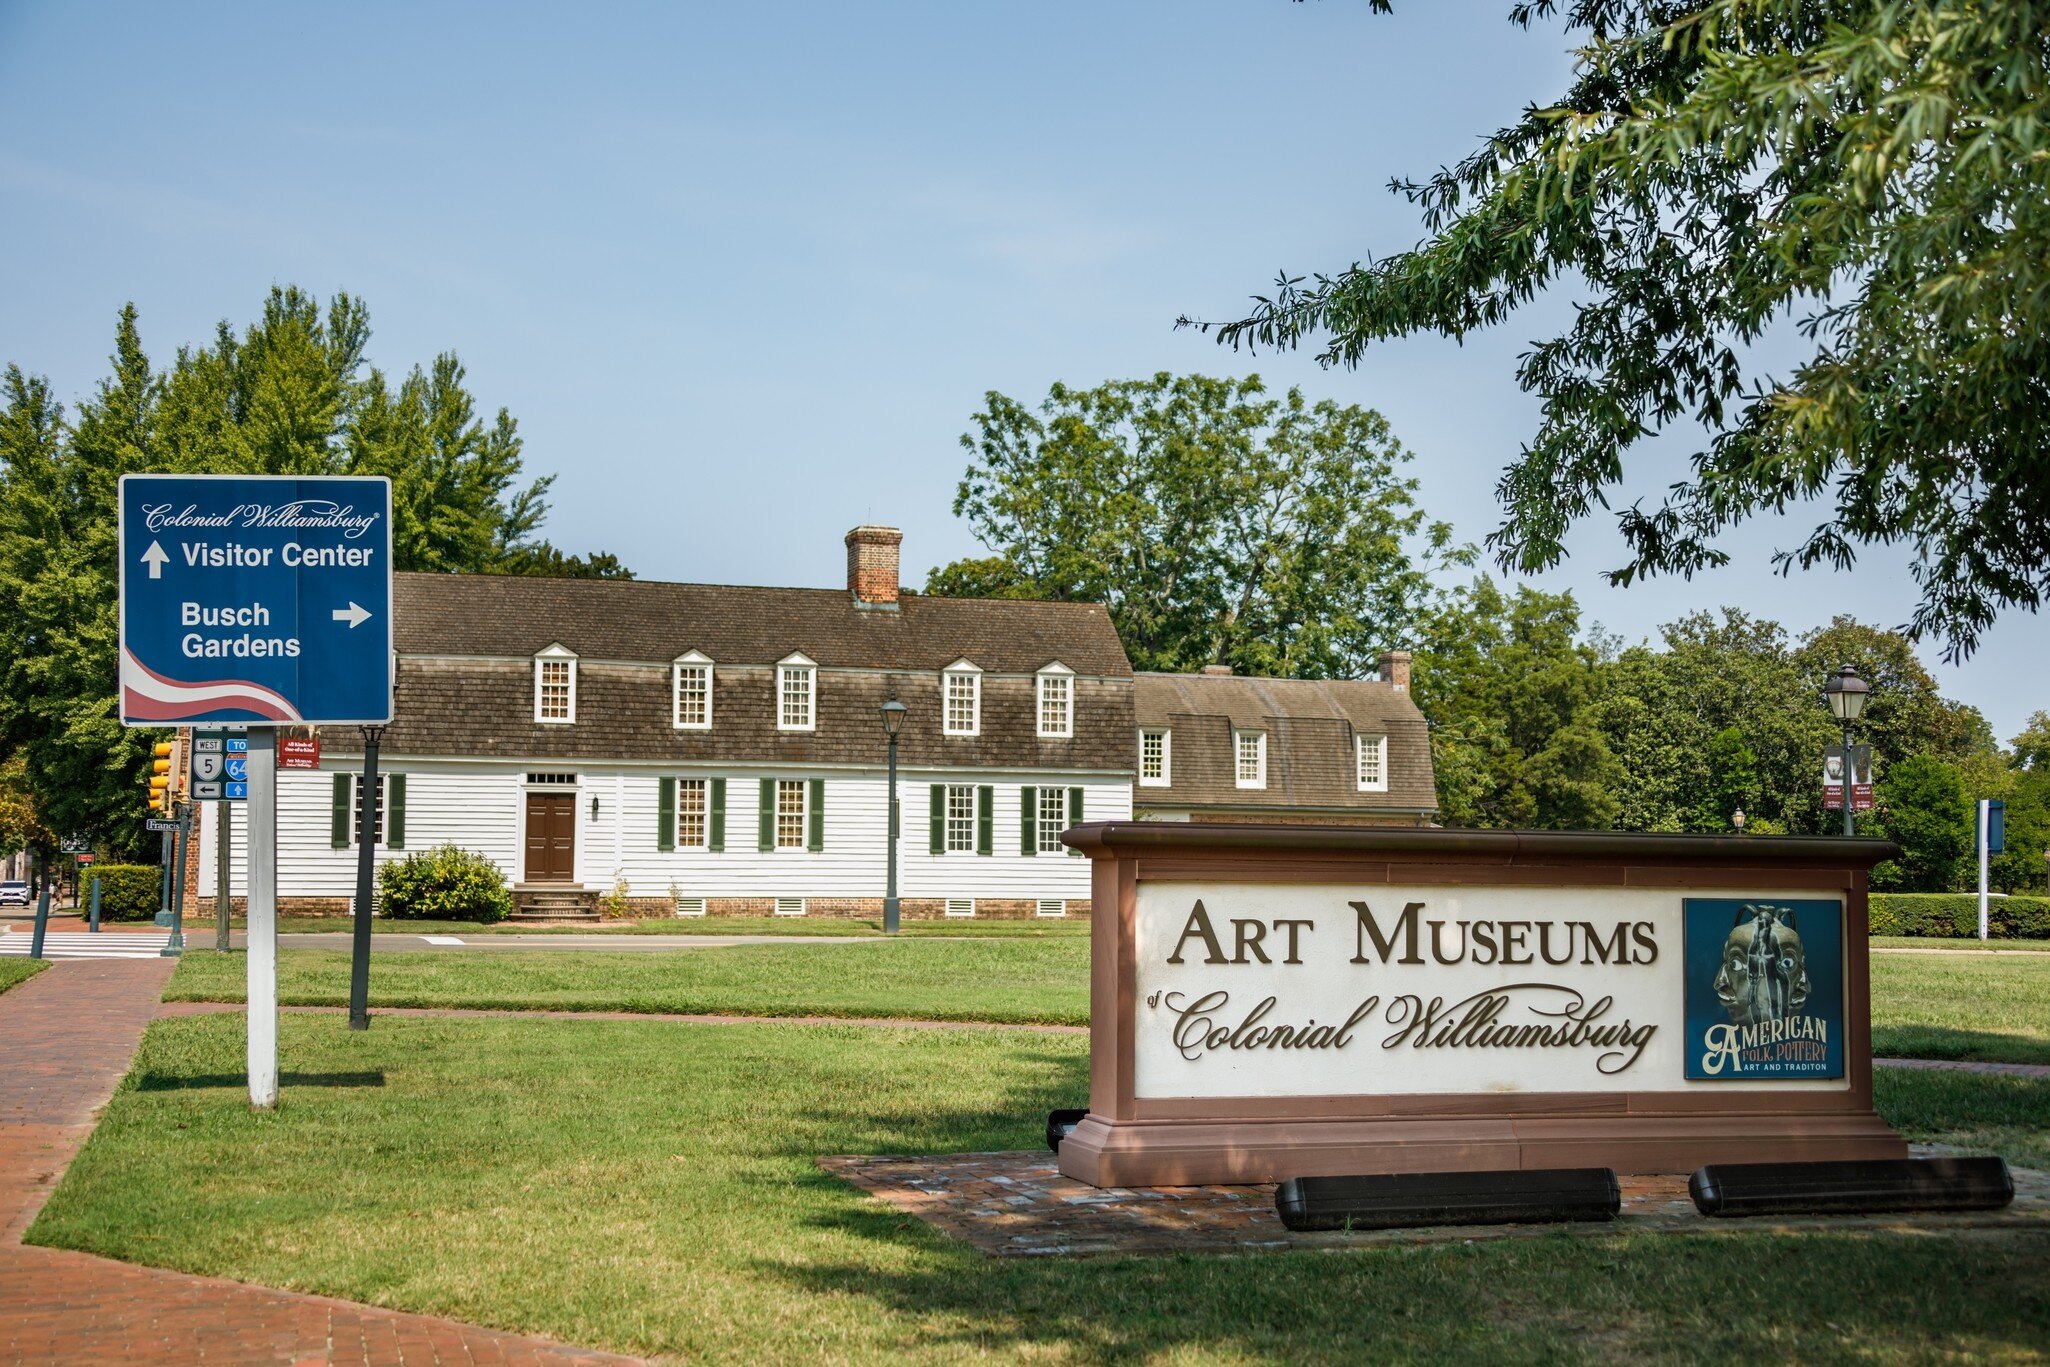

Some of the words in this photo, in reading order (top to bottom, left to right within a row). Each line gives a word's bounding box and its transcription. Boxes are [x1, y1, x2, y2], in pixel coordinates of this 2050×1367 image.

[142, 503, 246, 533] Colonial
[182, 542, 273, 567] Visitor
[281, 542, 374, 567] Center
[181, 602, 270, 626] Busch
[181, 633, 301, 658] Gardens
[199, 741, 218, 750] WEST
[233, 741, 247, 750] TO
[204, 758, 213, 774] 5
[229, 760, 248, 776] 64
[149, 820, 180, 830] Francis
[1166, 898, 1314, 965] ART
[1347, 900, 1659, 966] MUSEUMS
[1147, 989, 1162, 1010] of
[1164, 990, 1380, 1061] Colonial
[1381, 982, 1659, 1075] Williamsburg
[1701, 1015, 1827, 1075] AMERICAN
[1742, 1045, 1774, 1062] FOLK
[1776, 1040, 1827, 1062] POTTERY
[1743, 1063, 1760, 1071] ART
[1763, 1063, 1781, 1071] AND
[1784, 1063, 1827, 1071] TRADITON
